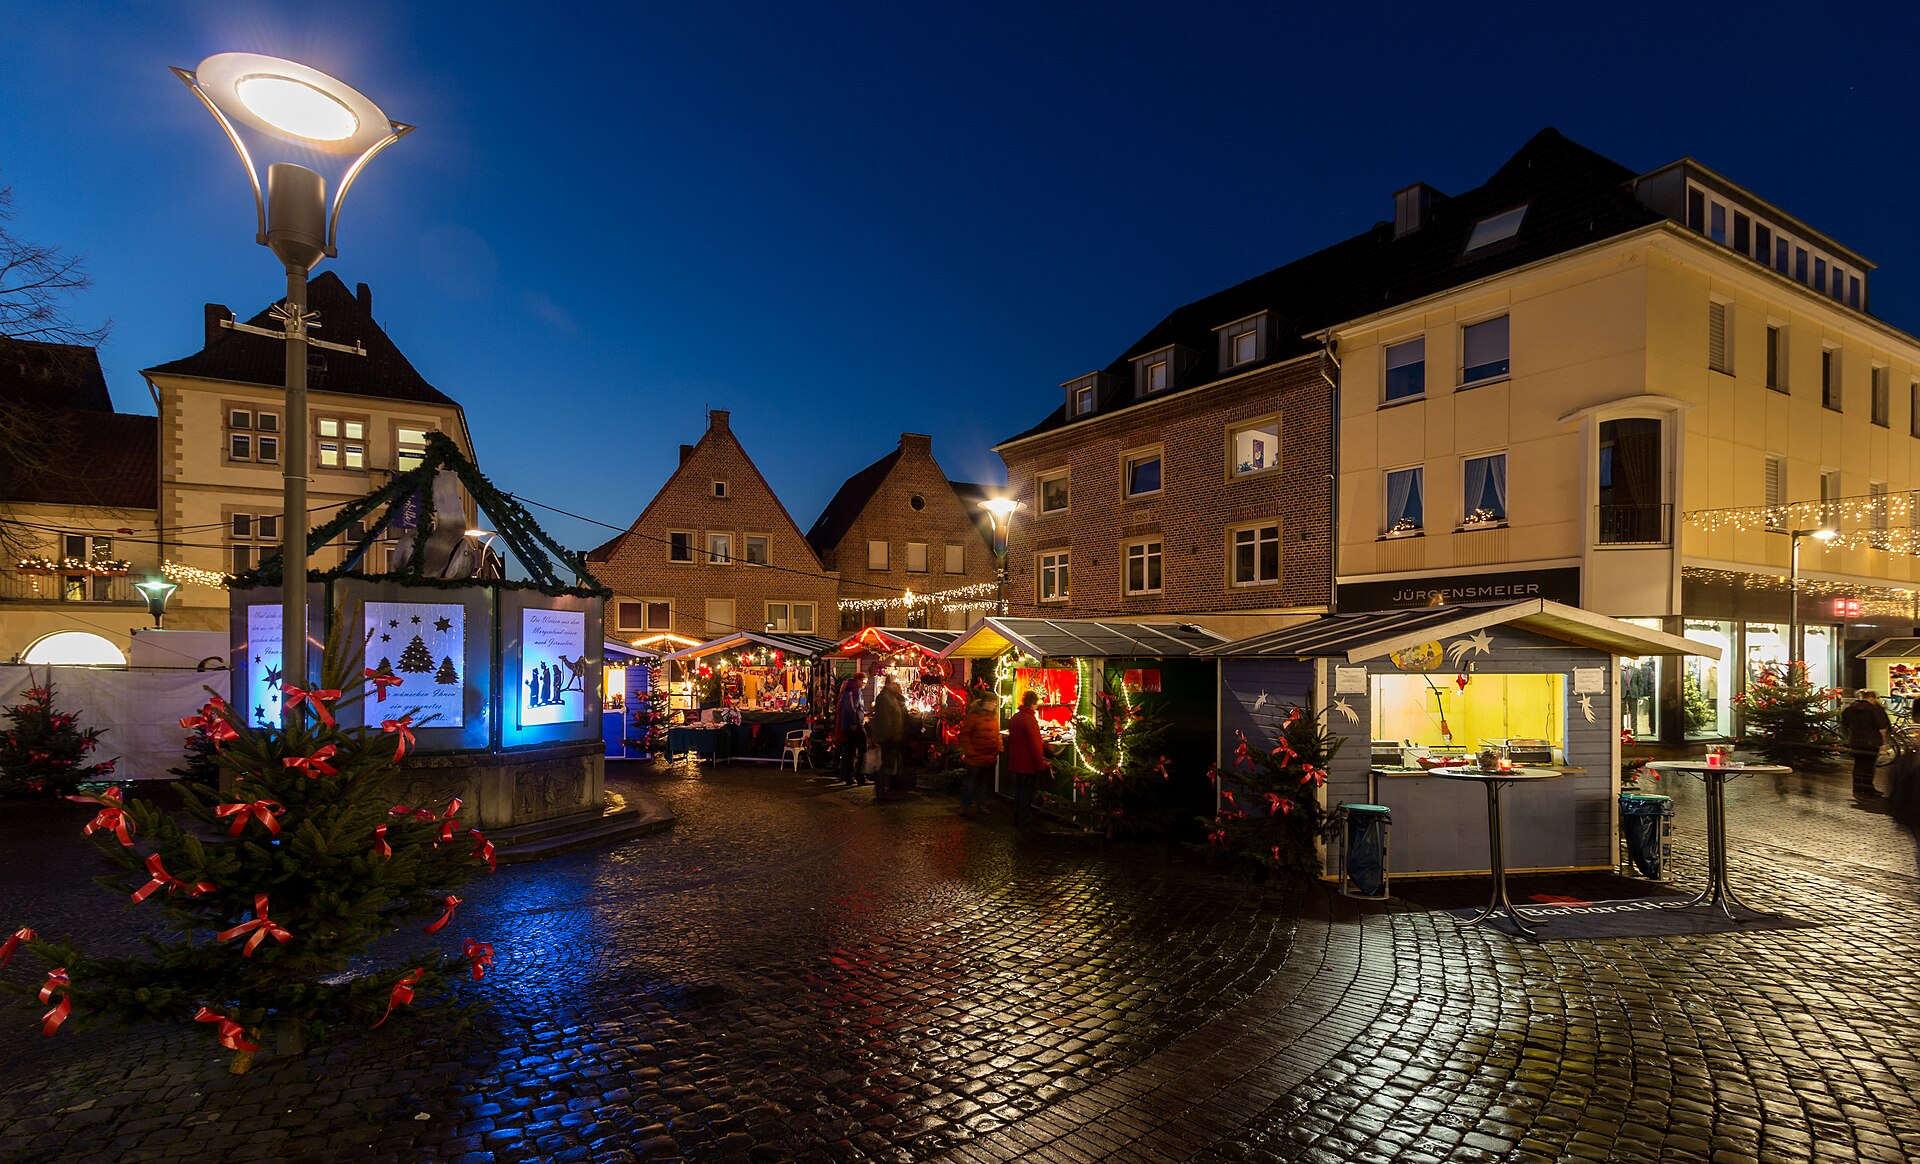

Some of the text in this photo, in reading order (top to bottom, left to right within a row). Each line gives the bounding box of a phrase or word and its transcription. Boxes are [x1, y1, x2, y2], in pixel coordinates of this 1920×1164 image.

[1393, 584, 1539, 601] JÜRGENSMEIER
[529, 615, 541, 623] Die
[542, 615, 560, 624] Weisen
[393, 689, 429, 697] wünschen
[432, 688, 456, 698] Ihnen
[1515, 905, 1640, 916] Barbara
